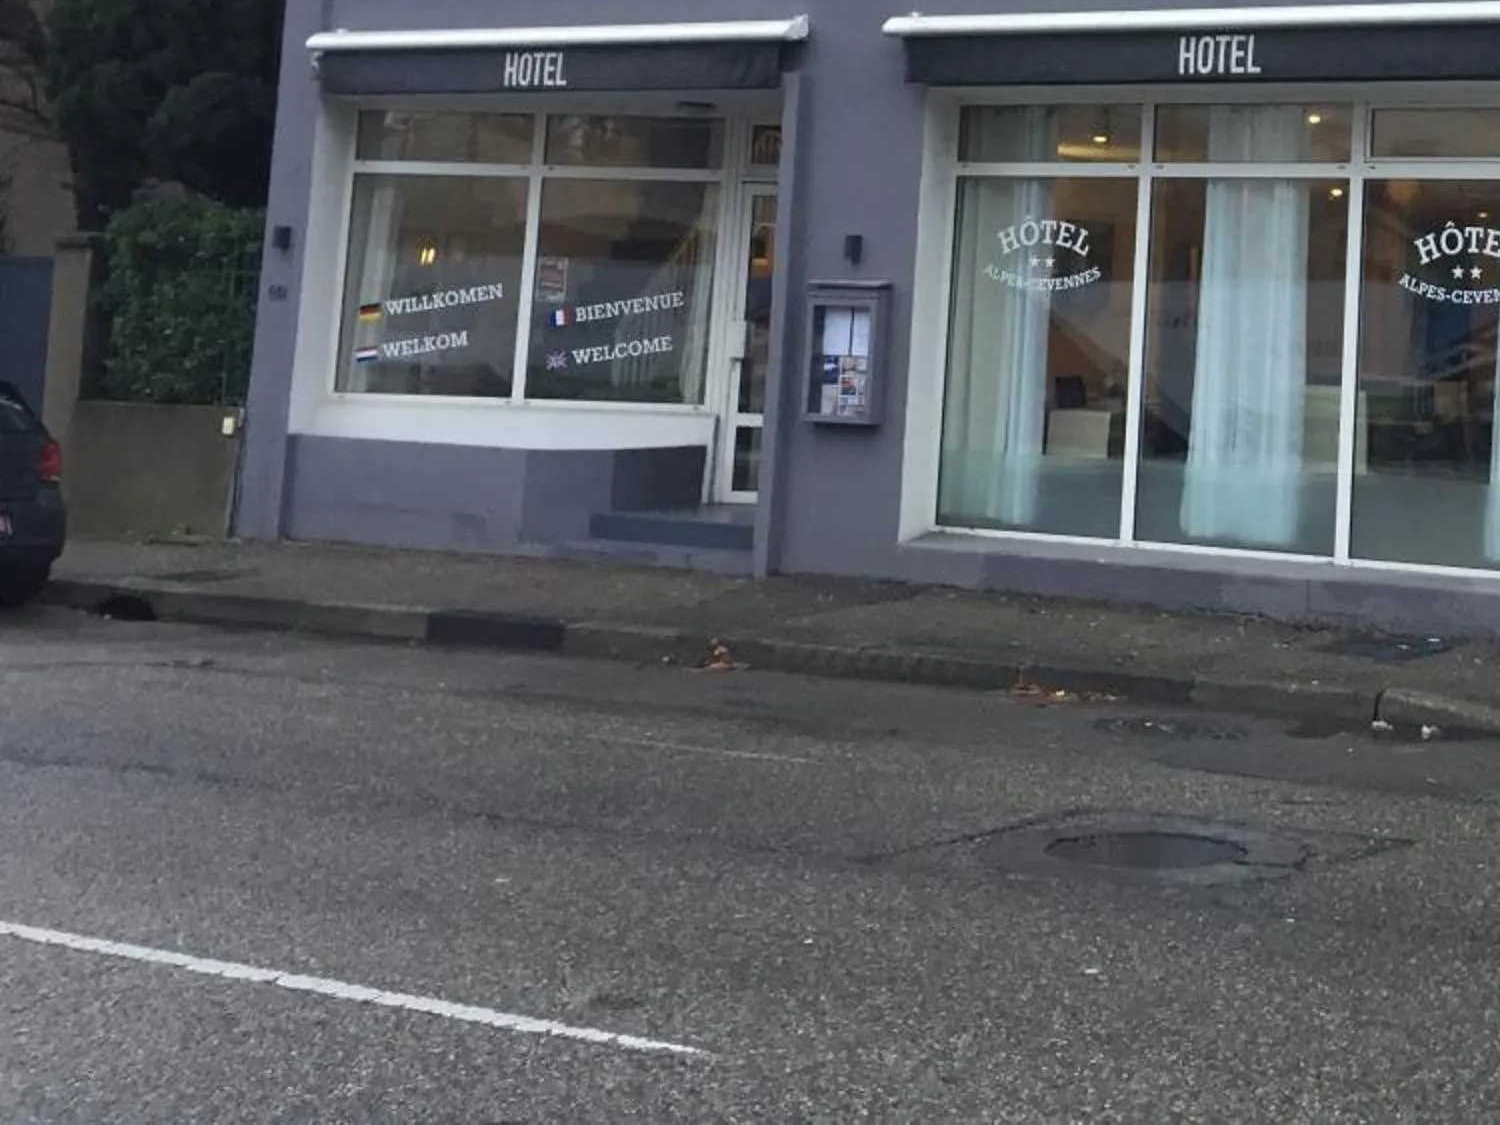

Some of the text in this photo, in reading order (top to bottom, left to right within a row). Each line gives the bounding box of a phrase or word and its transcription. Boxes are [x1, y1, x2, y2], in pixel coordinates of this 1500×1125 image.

[503, 52, 567, 87] HOTEL
[1178, 34, 1262, 77] HOTEL
[997, 216, 1090, 257] HÔTEL
[385, 283, 504, 316] WILLKOMEN
[575, 291, 685, 322] BIENVENUE
[382, 330, 468, 359] WELKOM
[572, 336, 673, 364] WELCOME
